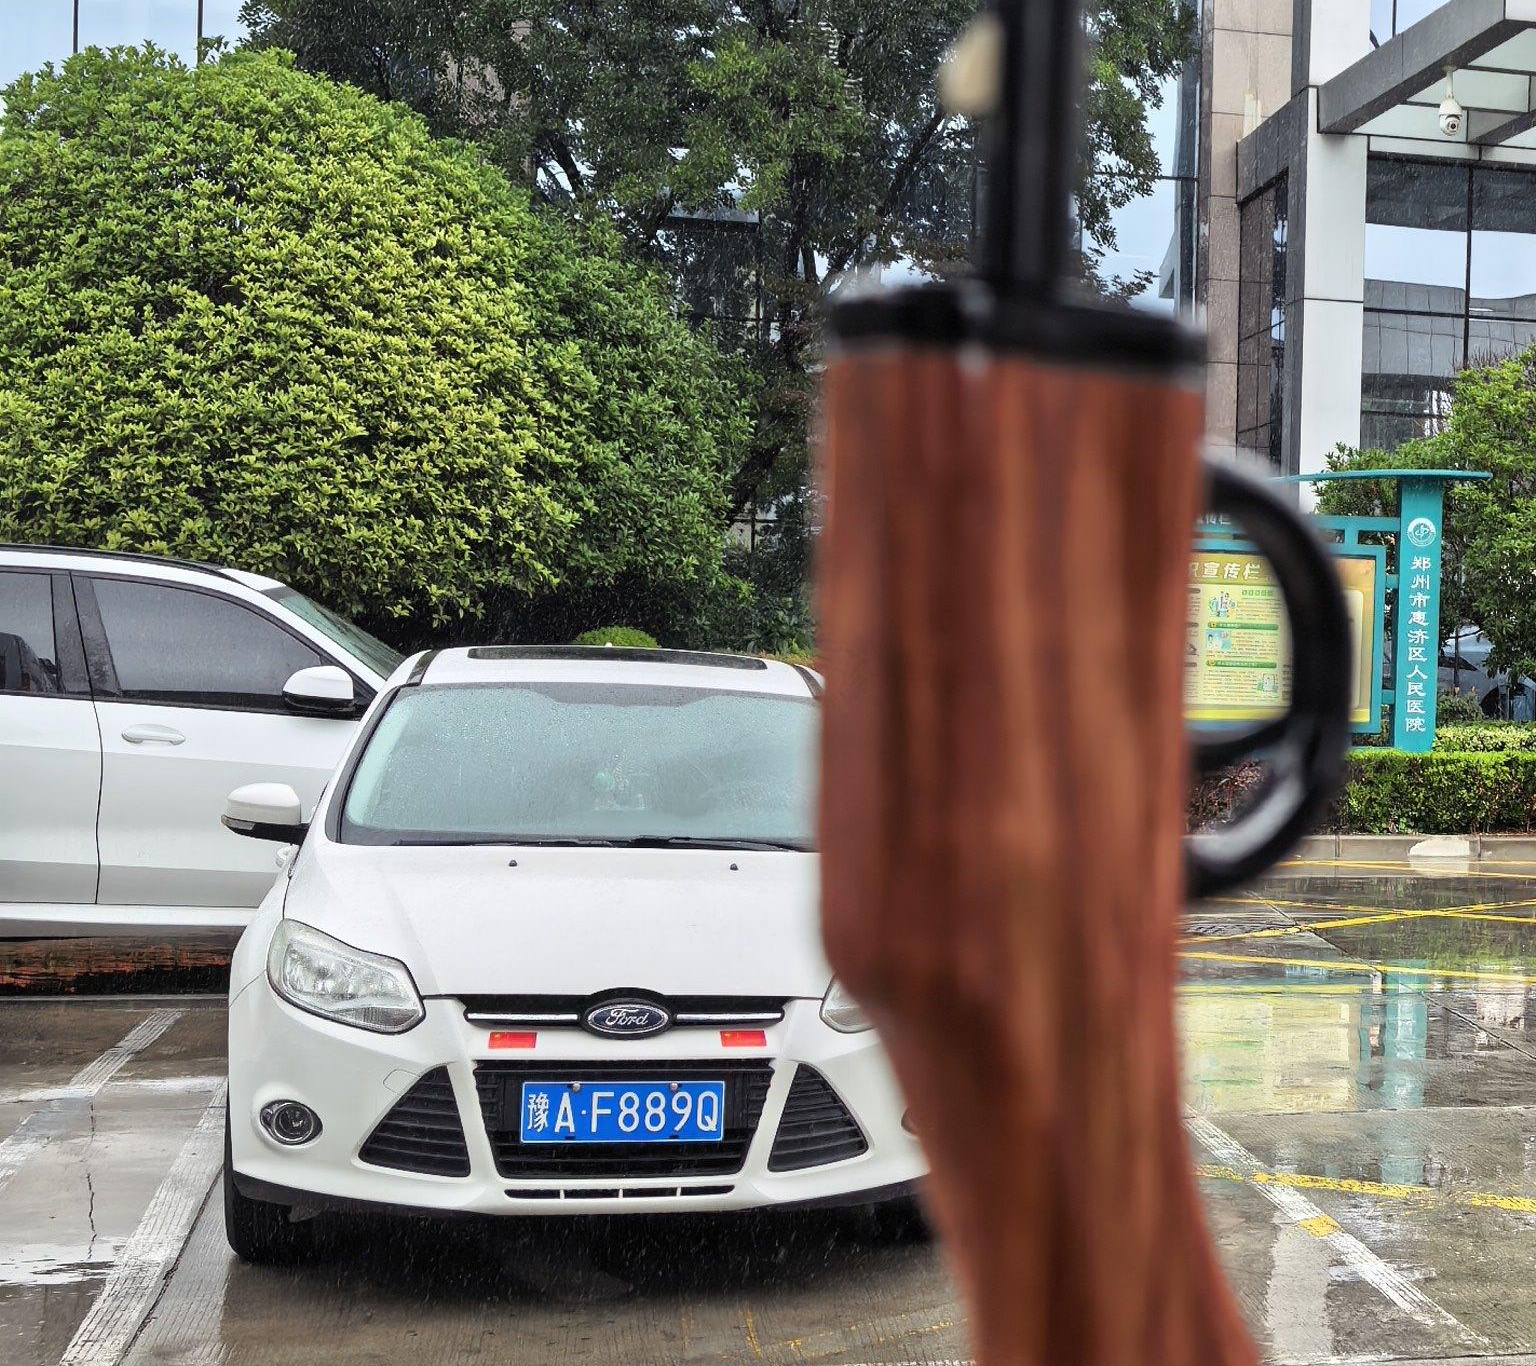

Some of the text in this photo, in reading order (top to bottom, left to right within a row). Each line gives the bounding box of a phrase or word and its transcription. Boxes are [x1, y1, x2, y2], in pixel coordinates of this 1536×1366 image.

[1405, 555, 1432, 733] 郑州市惠济区人民医院
[606, 1008, 649, 1026] Ford
